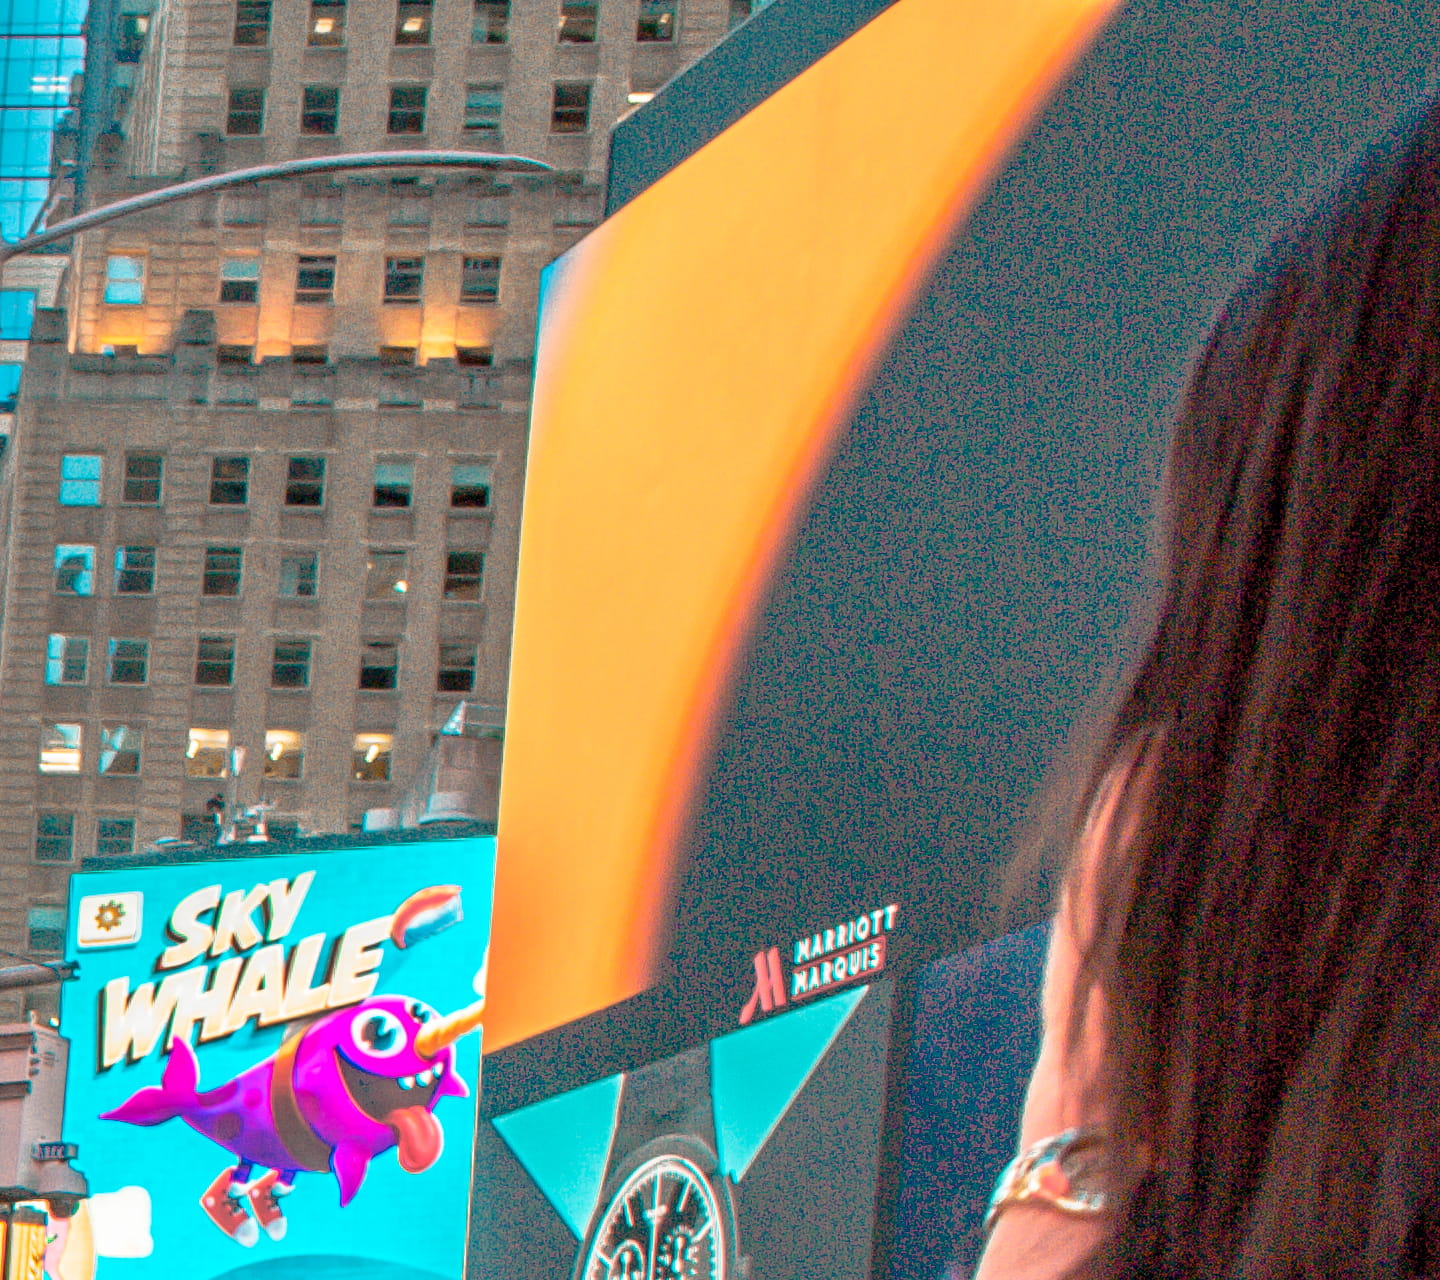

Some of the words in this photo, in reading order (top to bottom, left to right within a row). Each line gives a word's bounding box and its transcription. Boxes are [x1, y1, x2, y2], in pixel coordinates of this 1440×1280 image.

[156, 870, 318, 973] SKY
[793, 904, 899, 964] MARRIOTT
[96, 912, 400, 1076] WHALE
[791, 945, 882, 997] MARQUIS
